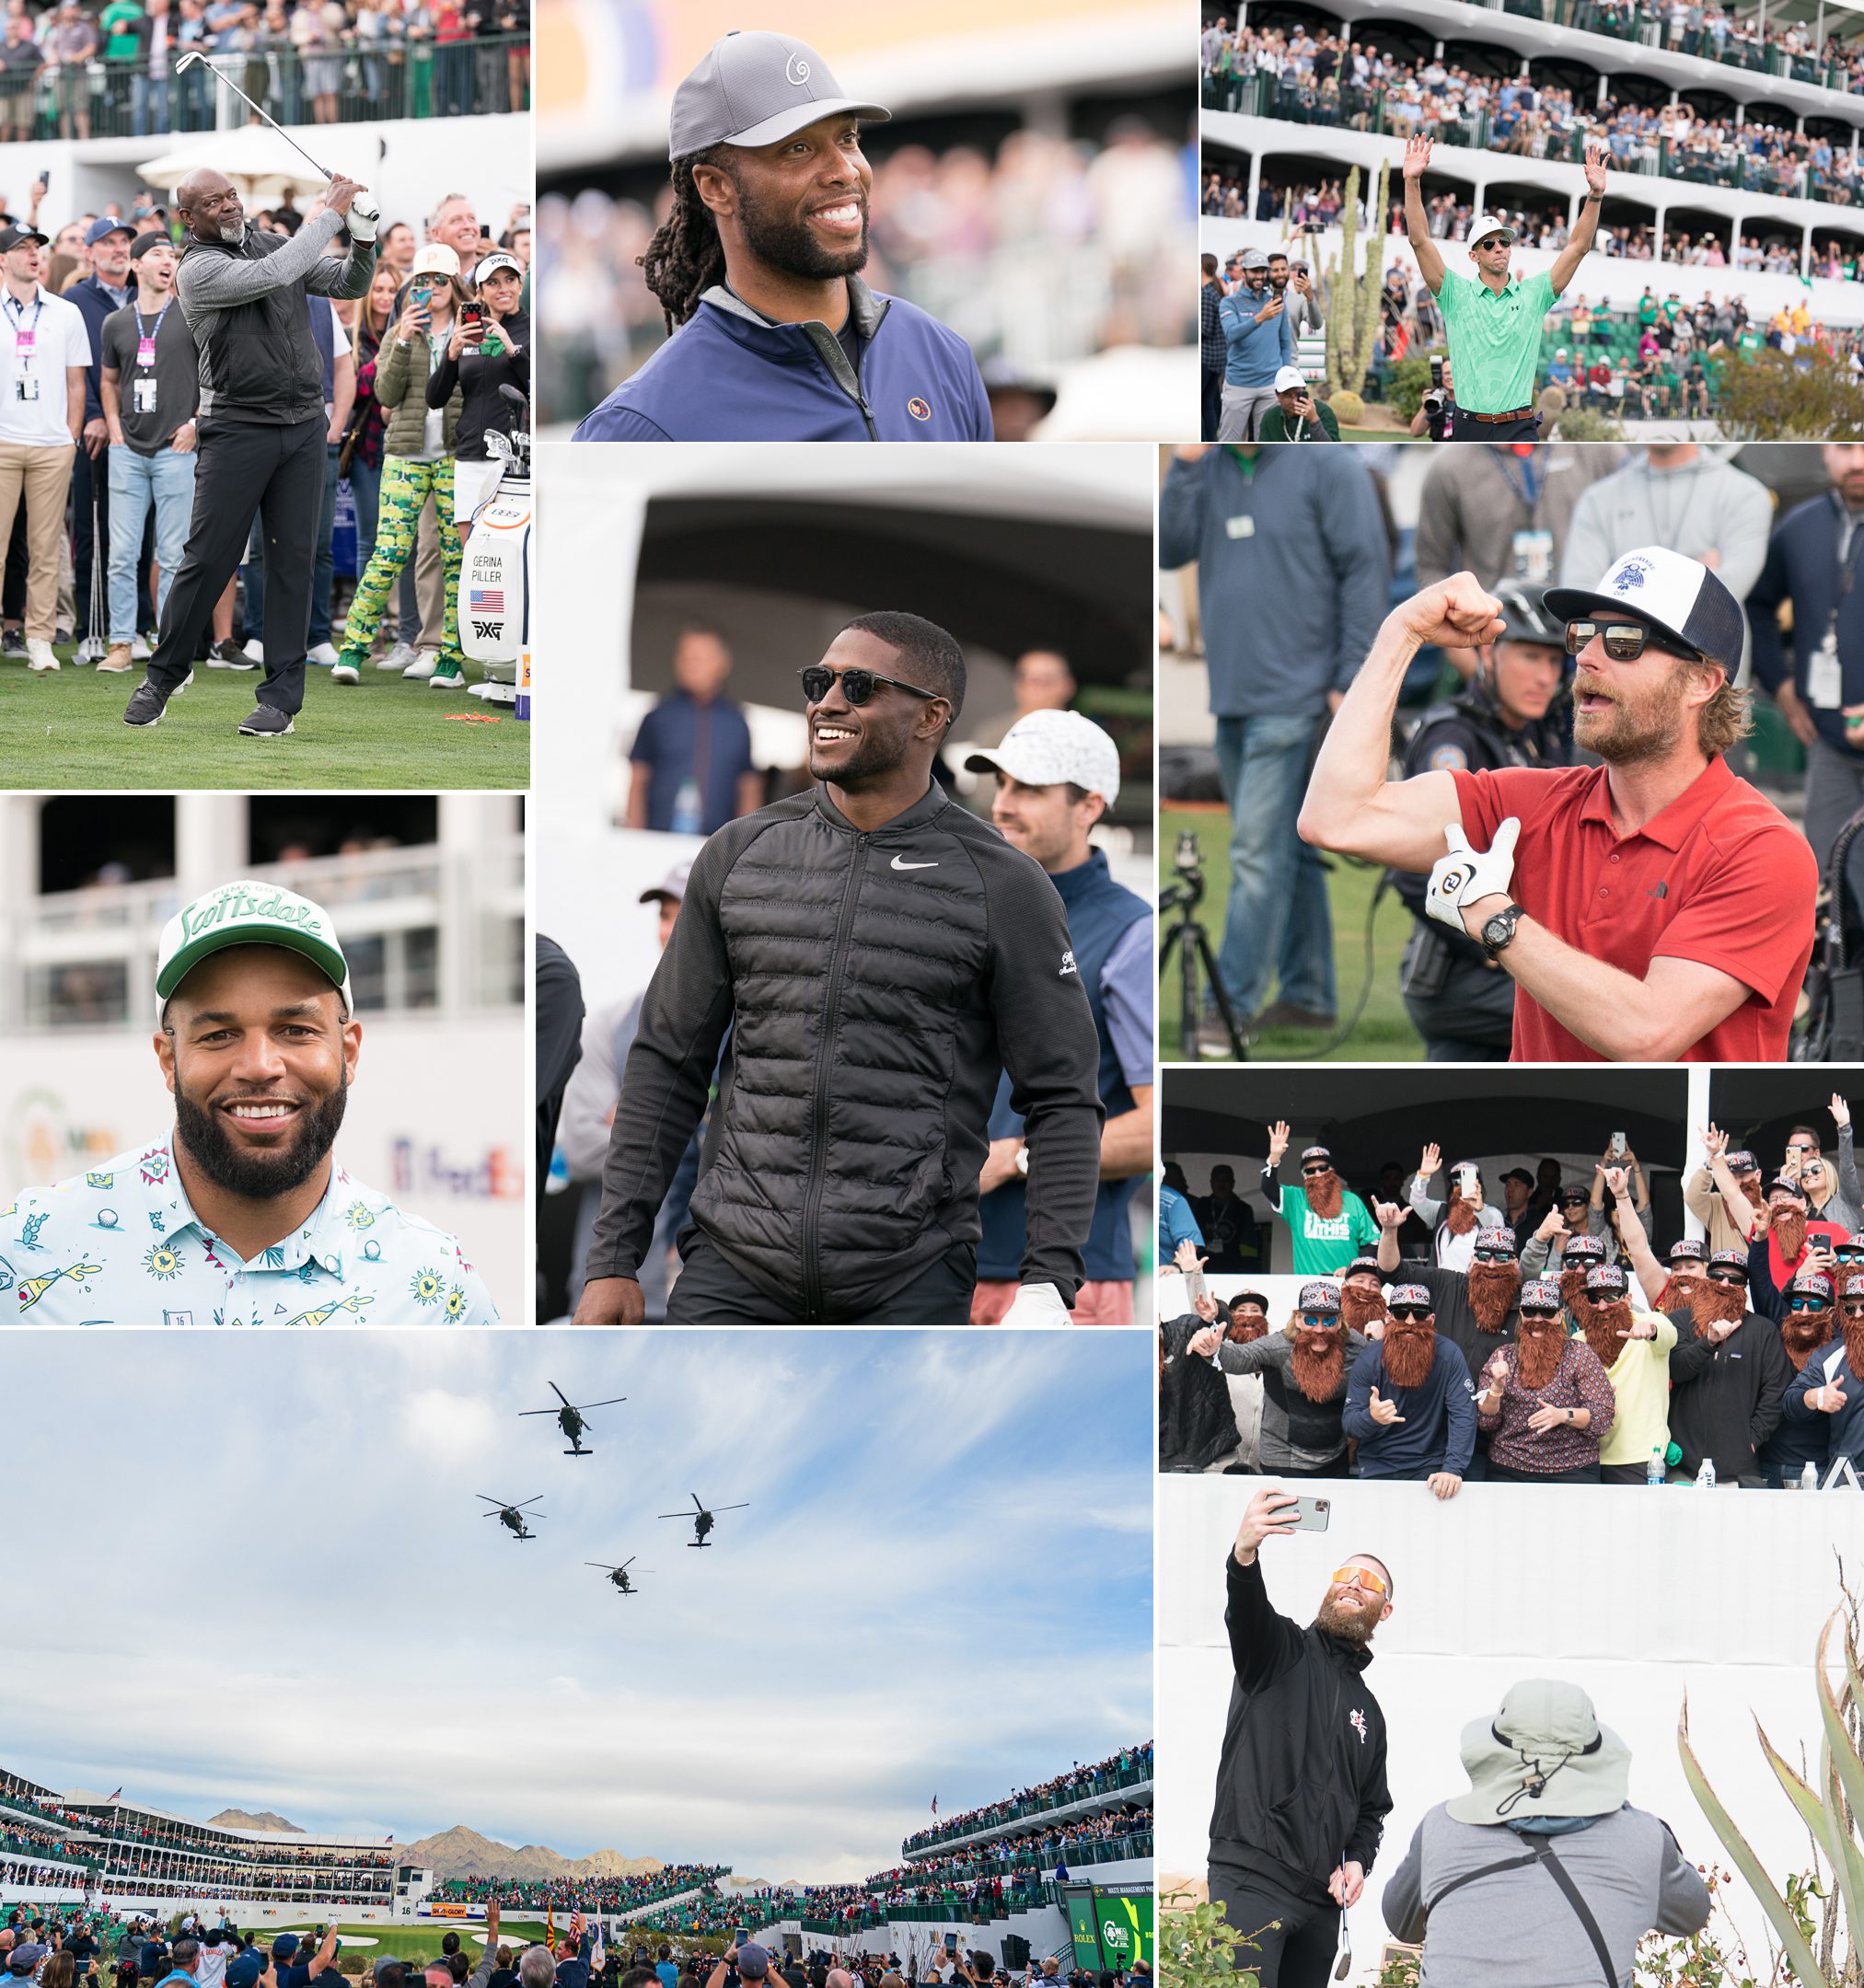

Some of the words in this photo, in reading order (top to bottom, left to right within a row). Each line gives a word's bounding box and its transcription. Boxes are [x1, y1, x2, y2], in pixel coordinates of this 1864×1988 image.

[106, 215, 119, 227] T
[473, 555, 503, 568] GERINA
[471, 570, 502, 583] PILLER
[471, 620, 504, 641] PXG
[213, 884, 251, 898] PUMA
[180, 891, 321, 949] Scottsdale
[1318, 1223, 1350, 1236] THIS
[401, 1906, 411, 1915] 16
[1073, 1934, 1095, 1944] ROLEX
